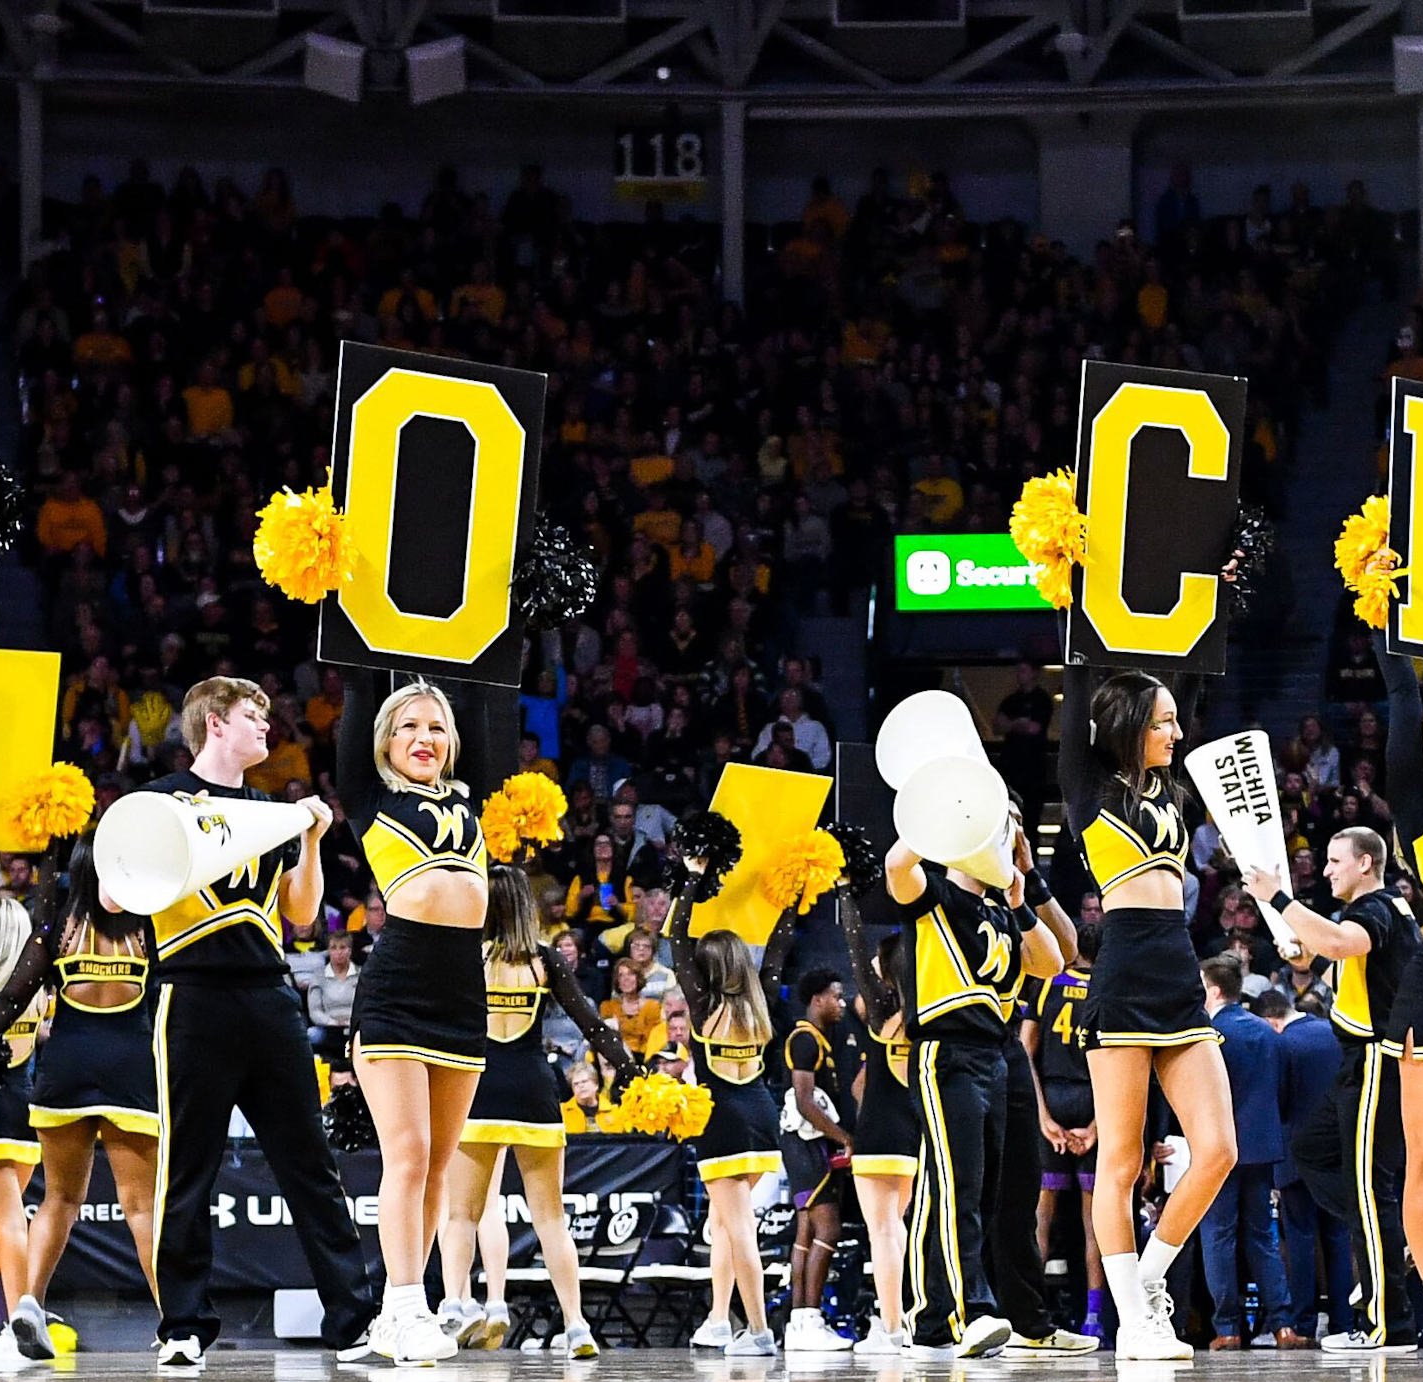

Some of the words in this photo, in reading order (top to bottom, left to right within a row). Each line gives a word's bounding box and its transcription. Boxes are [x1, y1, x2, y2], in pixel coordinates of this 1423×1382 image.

[618, 133, 702, 179] 118
[339, 367, 526, 665] O
[1081, 382, 1232, 659] C
[1215, 755, 1250, 818] STATE
[1234, 735, 1273, 826] WICHITA
[79, 961, 132, 976] SHOCKERS
[1051, 1001, 1074, 1045] 4
